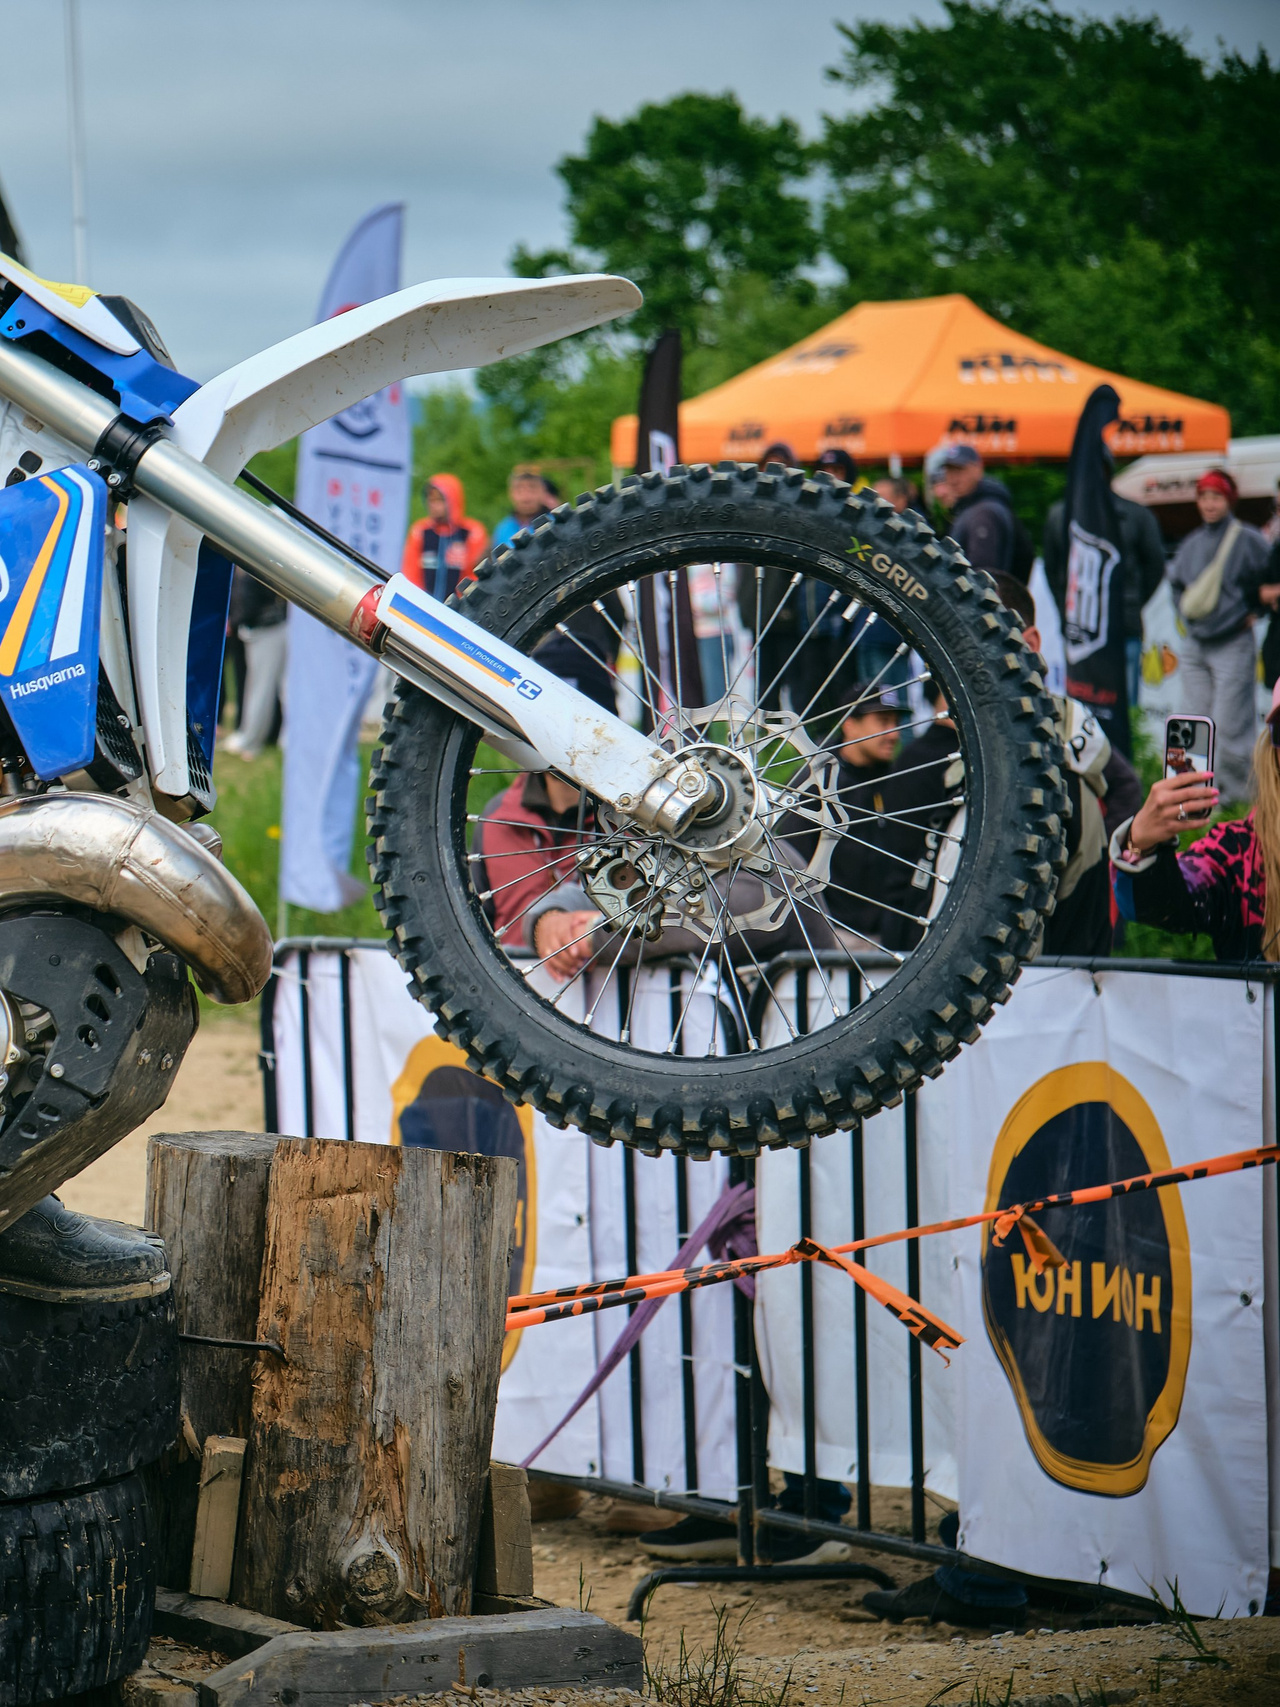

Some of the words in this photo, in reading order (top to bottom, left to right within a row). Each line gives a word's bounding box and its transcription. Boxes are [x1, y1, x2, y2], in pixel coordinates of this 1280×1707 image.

[950, 415, 1017, 433] KTM
[1120, 415, 1183, 433] KTM
[461, 641, 475, 652] FOR
[475, 650, 506, 674] PIONEERS
[10, 663, 86, 699] Husqvarna
[1010, 1253, 1162, 1335] ЮНИОН
